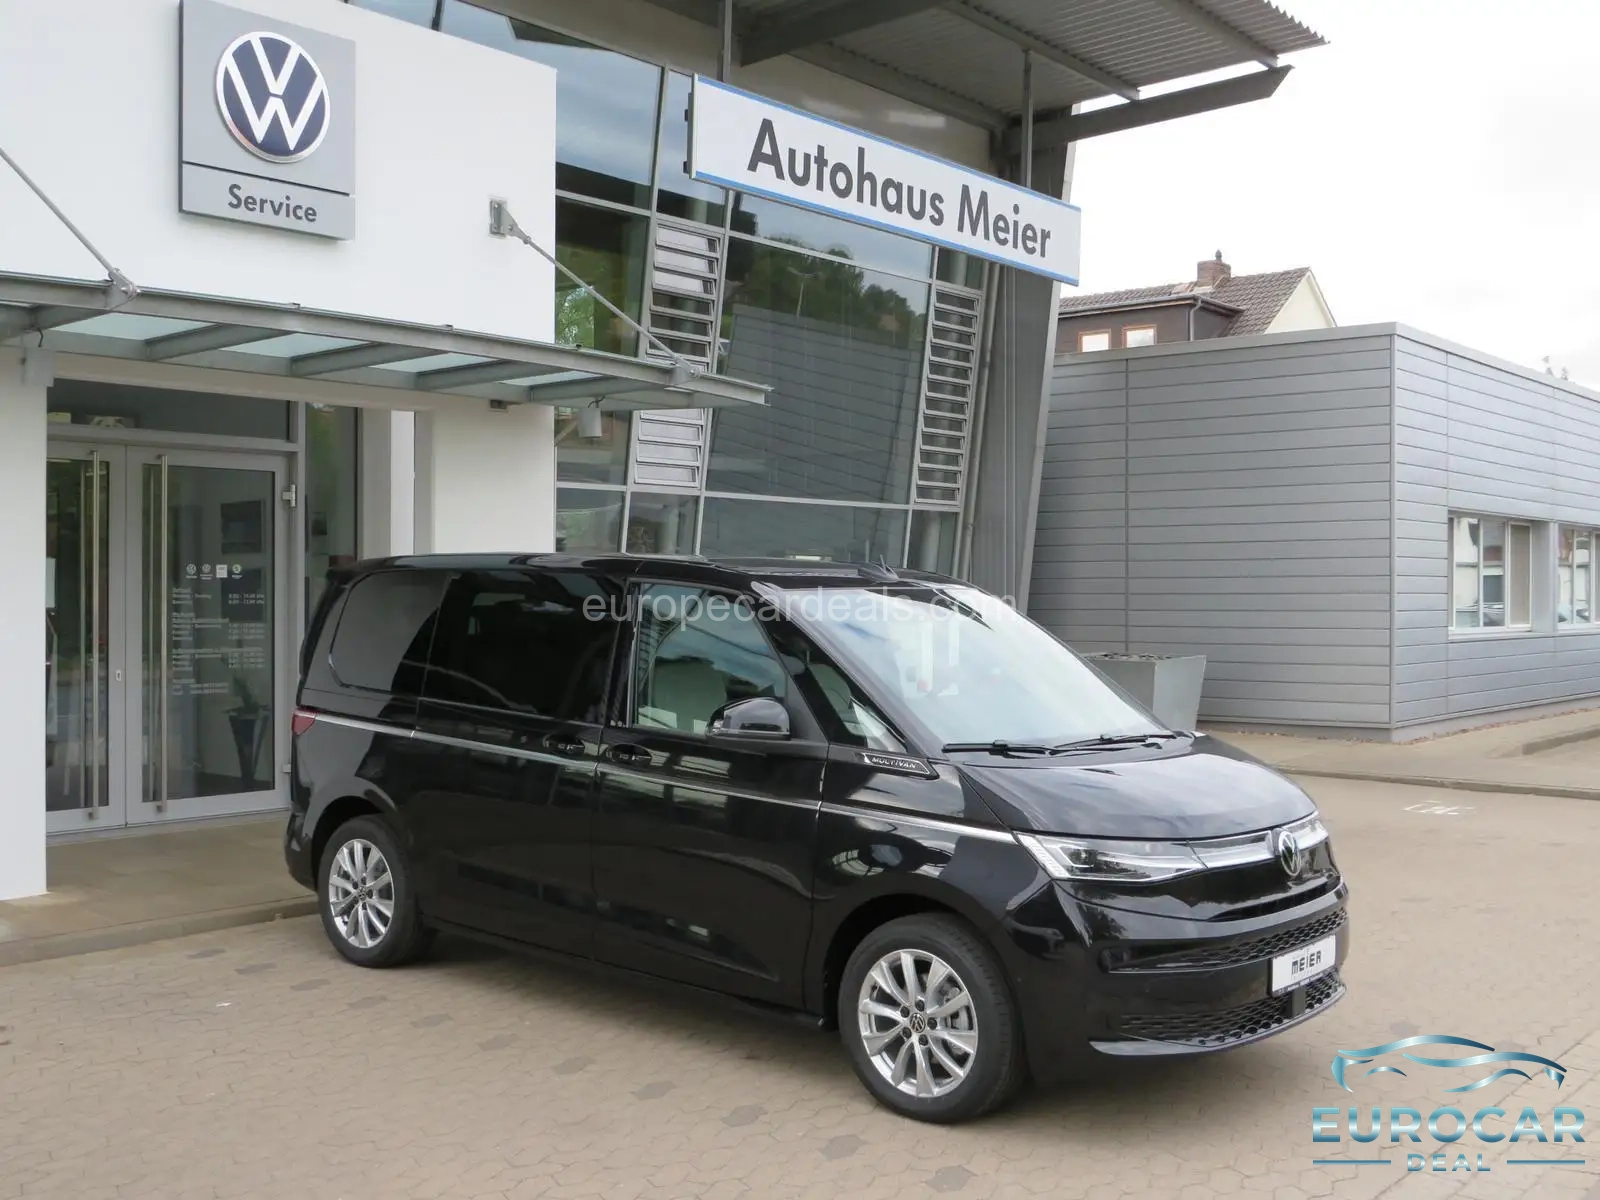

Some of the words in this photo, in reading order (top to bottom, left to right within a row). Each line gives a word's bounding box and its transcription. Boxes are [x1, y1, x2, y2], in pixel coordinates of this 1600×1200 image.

[215, 31, 331, 163] VW
[227, 183, 318, 223] Service
[747, 118, 944, 226] Autohaus
[957, 183, 1051, 258] Meier
[871, 757, 916, 769] MULTIVAN
[1291, 950, 1322, 975] MEIER
